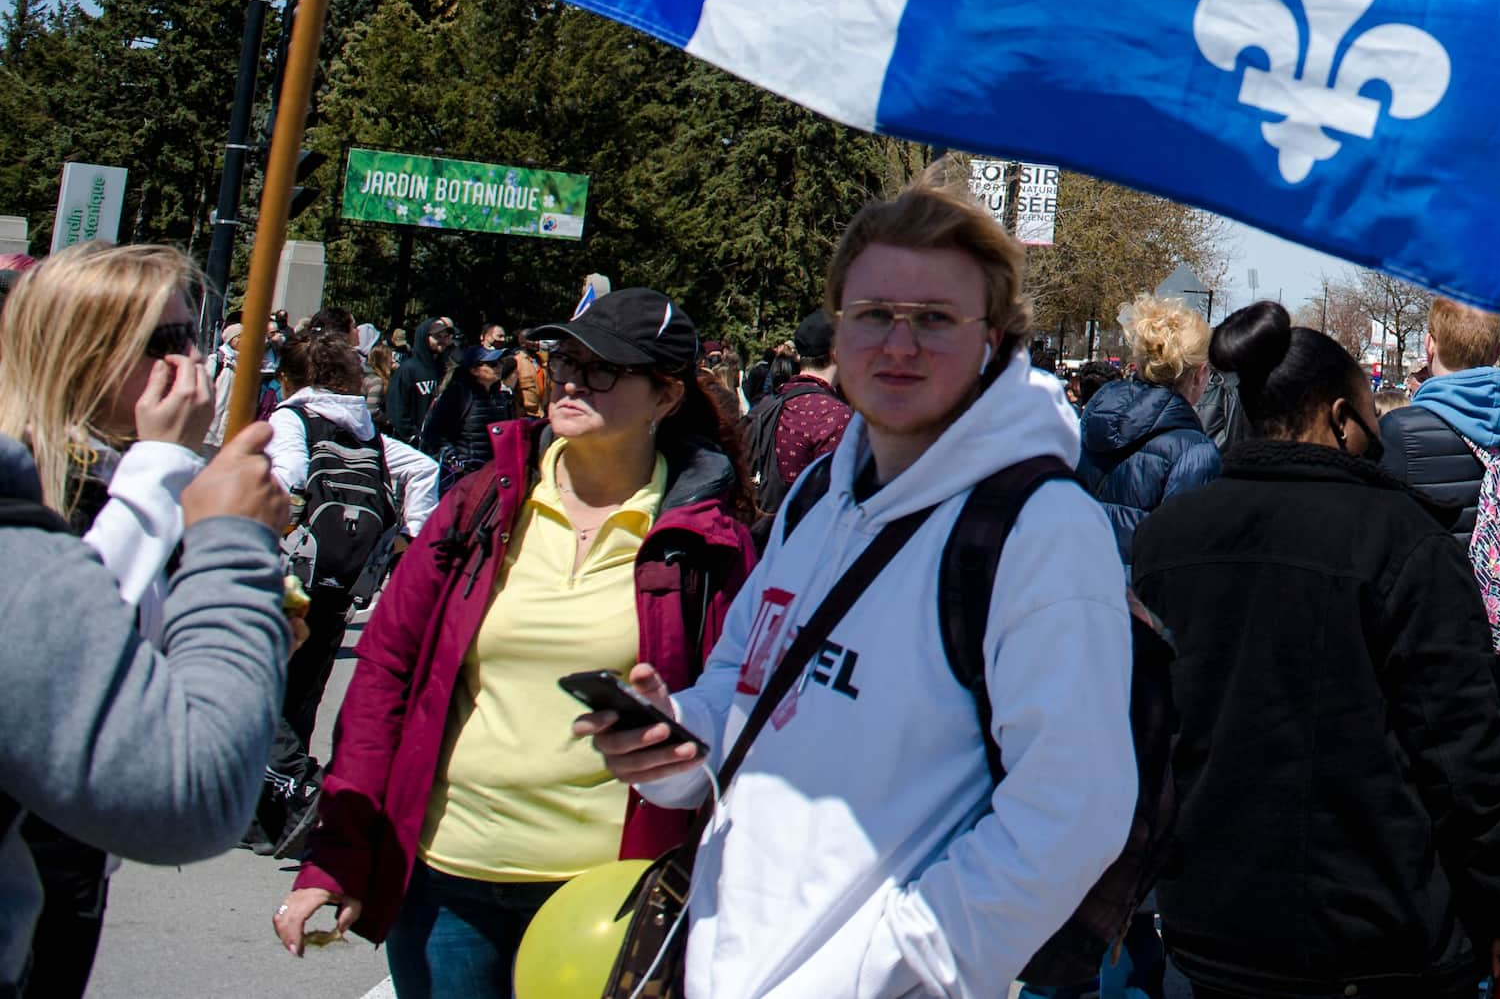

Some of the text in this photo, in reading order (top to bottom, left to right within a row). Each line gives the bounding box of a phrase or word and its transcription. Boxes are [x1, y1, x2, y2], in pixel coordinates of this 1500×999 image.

[83, 176, 105, 241] otanique
[361, 170, 540, 211] JARDIN BOTANIQUE
[65, 208, 83, 246] ardin
